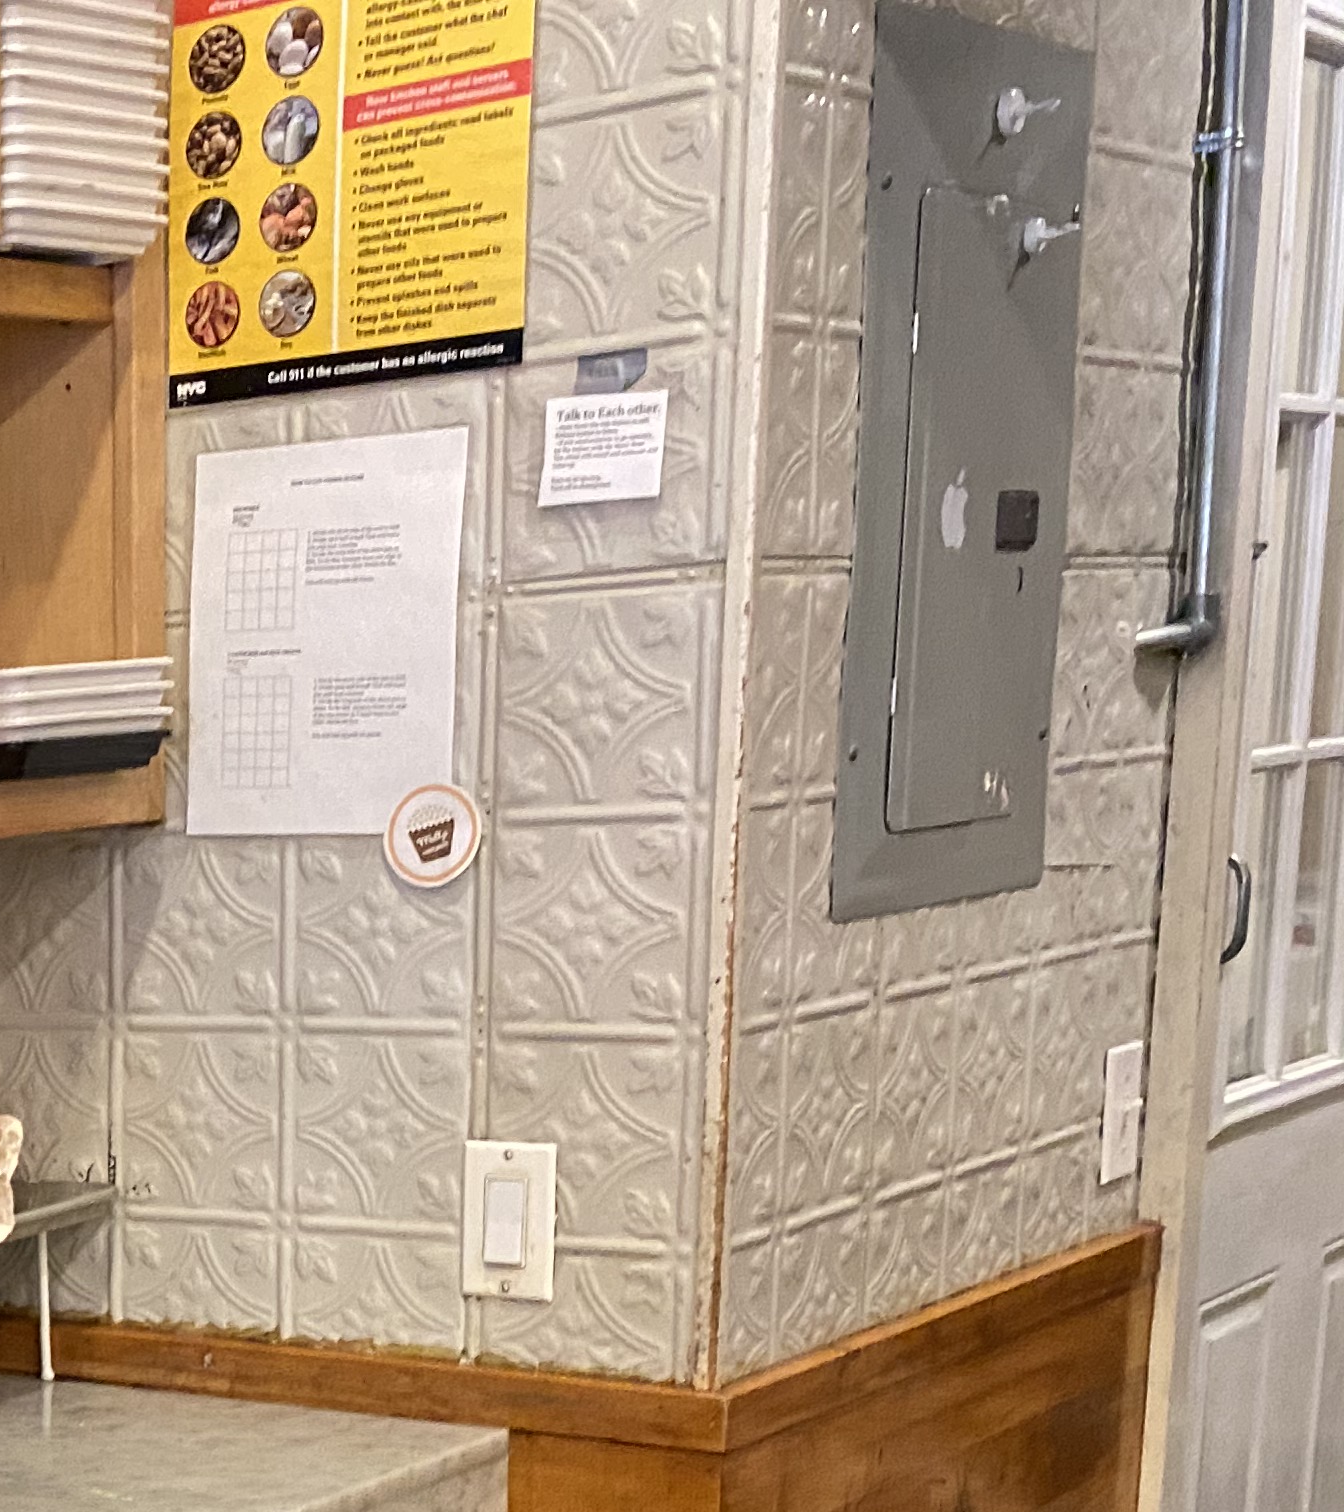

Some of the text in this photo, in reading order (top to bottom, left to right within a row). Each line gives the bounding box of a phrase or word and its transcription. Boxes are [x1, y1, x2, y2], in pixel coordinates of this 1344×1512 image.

[267, 371, 286, 384] Call
[289, 369, 305, 382] 911
[316, 364, 332, 378] the
[334, 360, 380, 376] customer
[382, 357, 400, 370] has
[402, 355, 415, 367] an
[417, 347, 457, 365] allergic
[460, 343, 504, 359] reaction
[557, 409, 580, 422] Talk
[584, 410, 595, 419] to
[598, 405, 624, 419] Each
